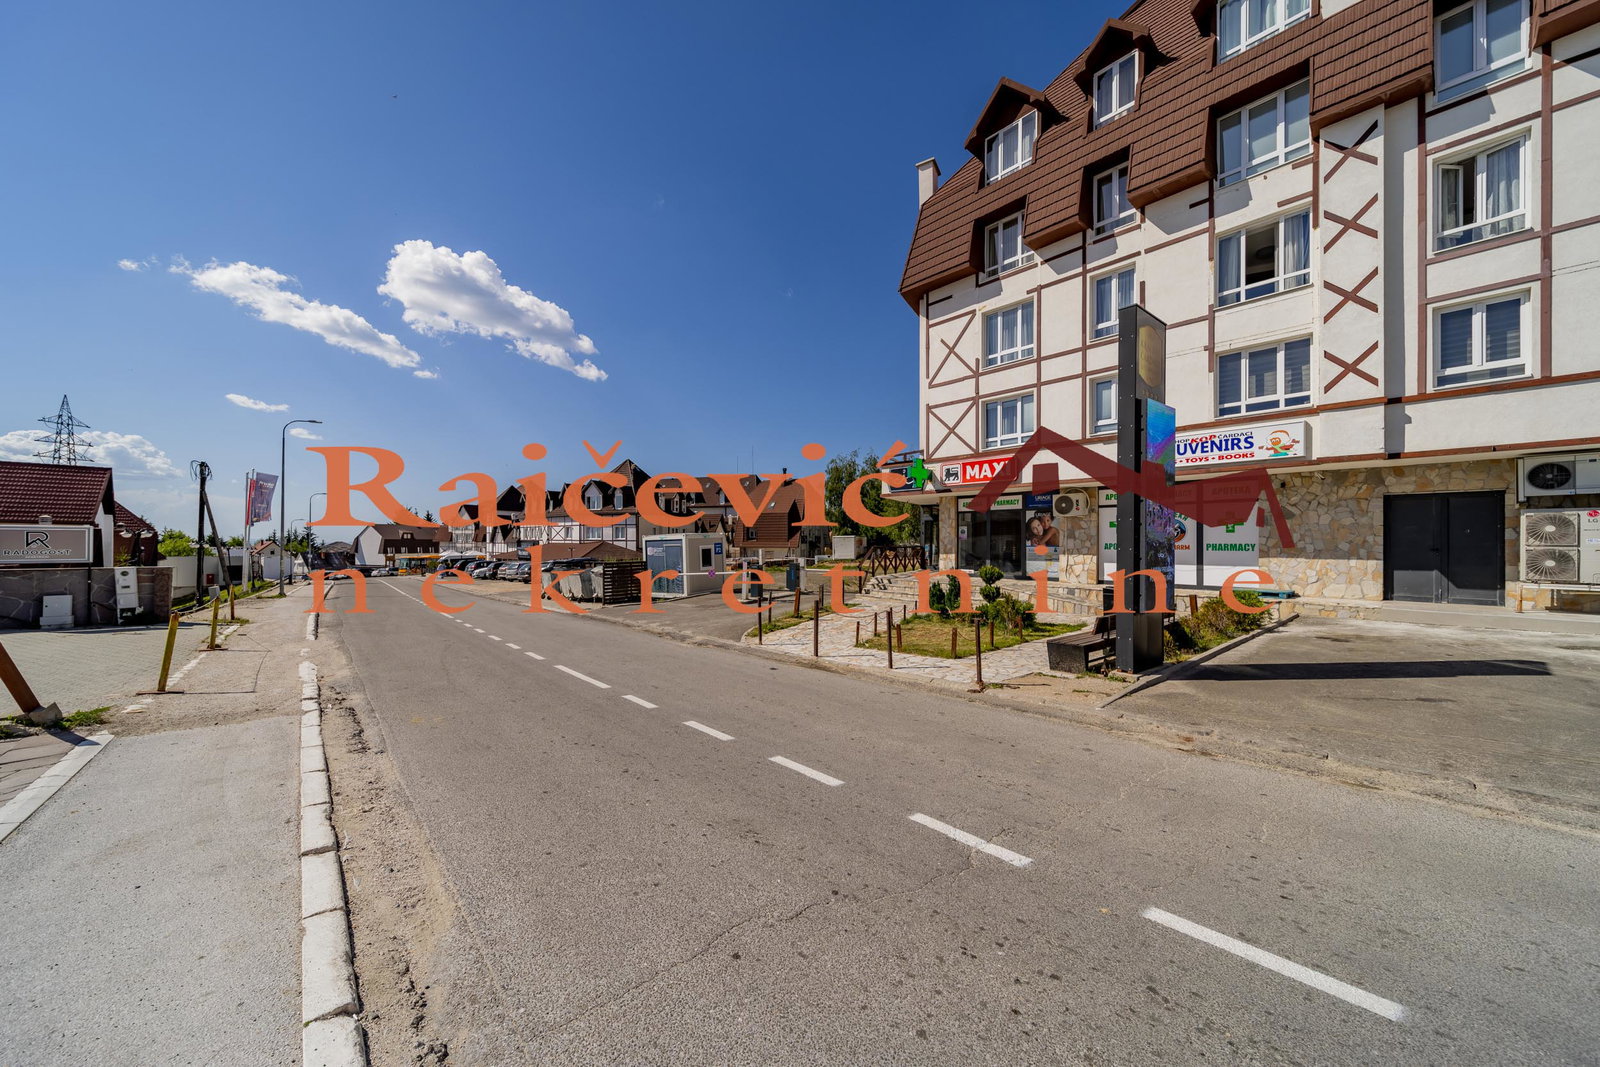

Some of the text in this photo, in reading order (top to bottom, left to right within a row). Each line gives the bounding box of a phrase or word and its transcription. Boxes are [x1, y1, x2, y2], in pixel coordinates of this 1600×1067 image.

[1190, 434, 1217, 444] KOP
[1176, 435, 1255, 456] UVENIRS
[1185, 452, 1255, 464] TOYS BOOKS
[1105, 493, 1118, 501] APO
[993, 499, 1020, 507] PHARMACY
[1104, 542, 1118, 550] APO
[1206, 543, 1256, 552] PHARMACY
